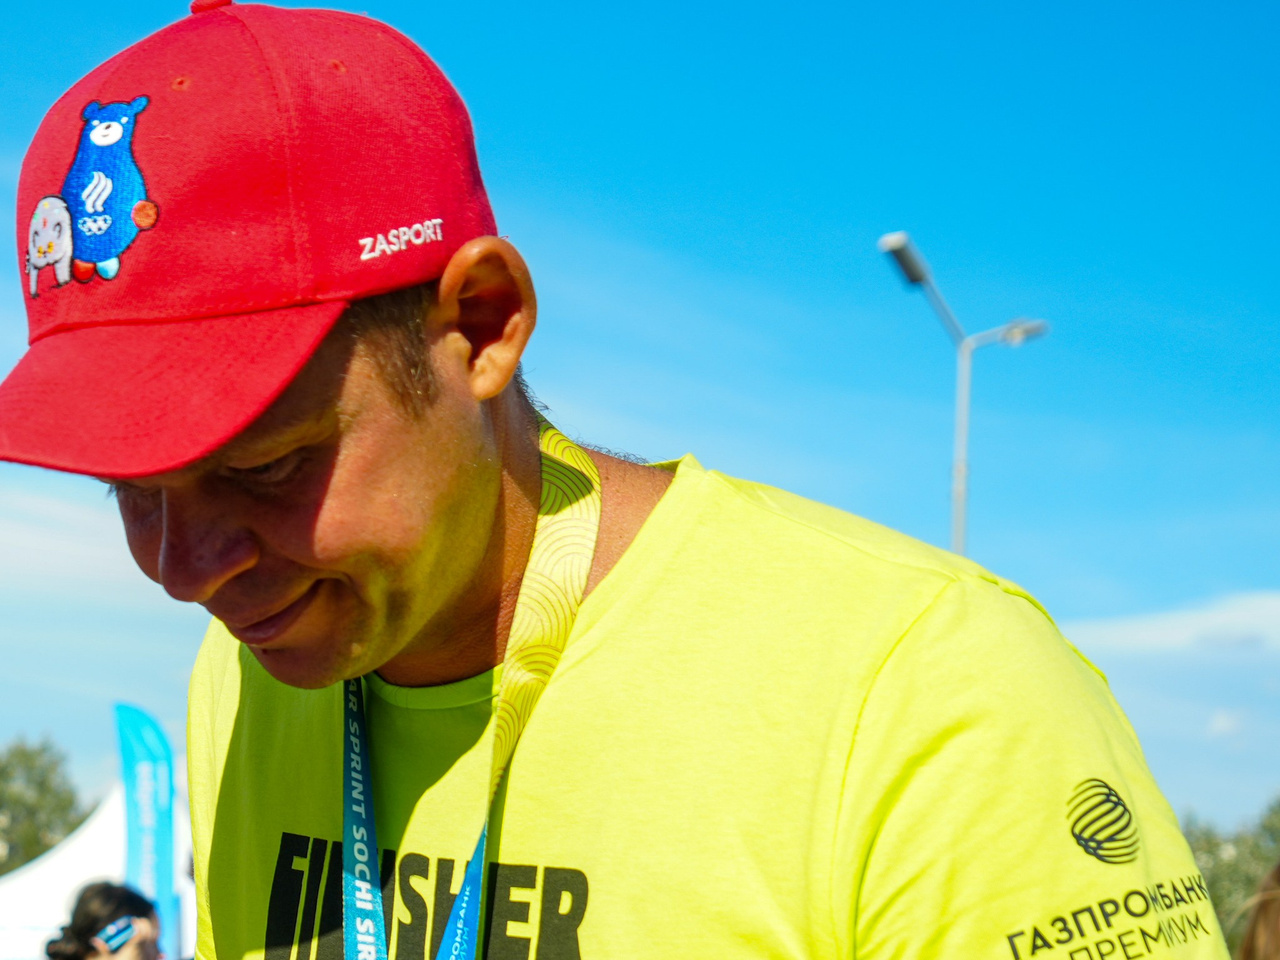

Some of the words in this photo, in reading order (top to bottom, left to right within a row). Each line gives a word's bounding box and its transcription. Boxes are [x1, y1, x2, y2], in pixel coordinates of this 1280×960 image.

[359, 218, 444, 260] ZASPORT
[348, 718, 366, 819] SPRINT
[352, 824, 374, 910] SOCHI
